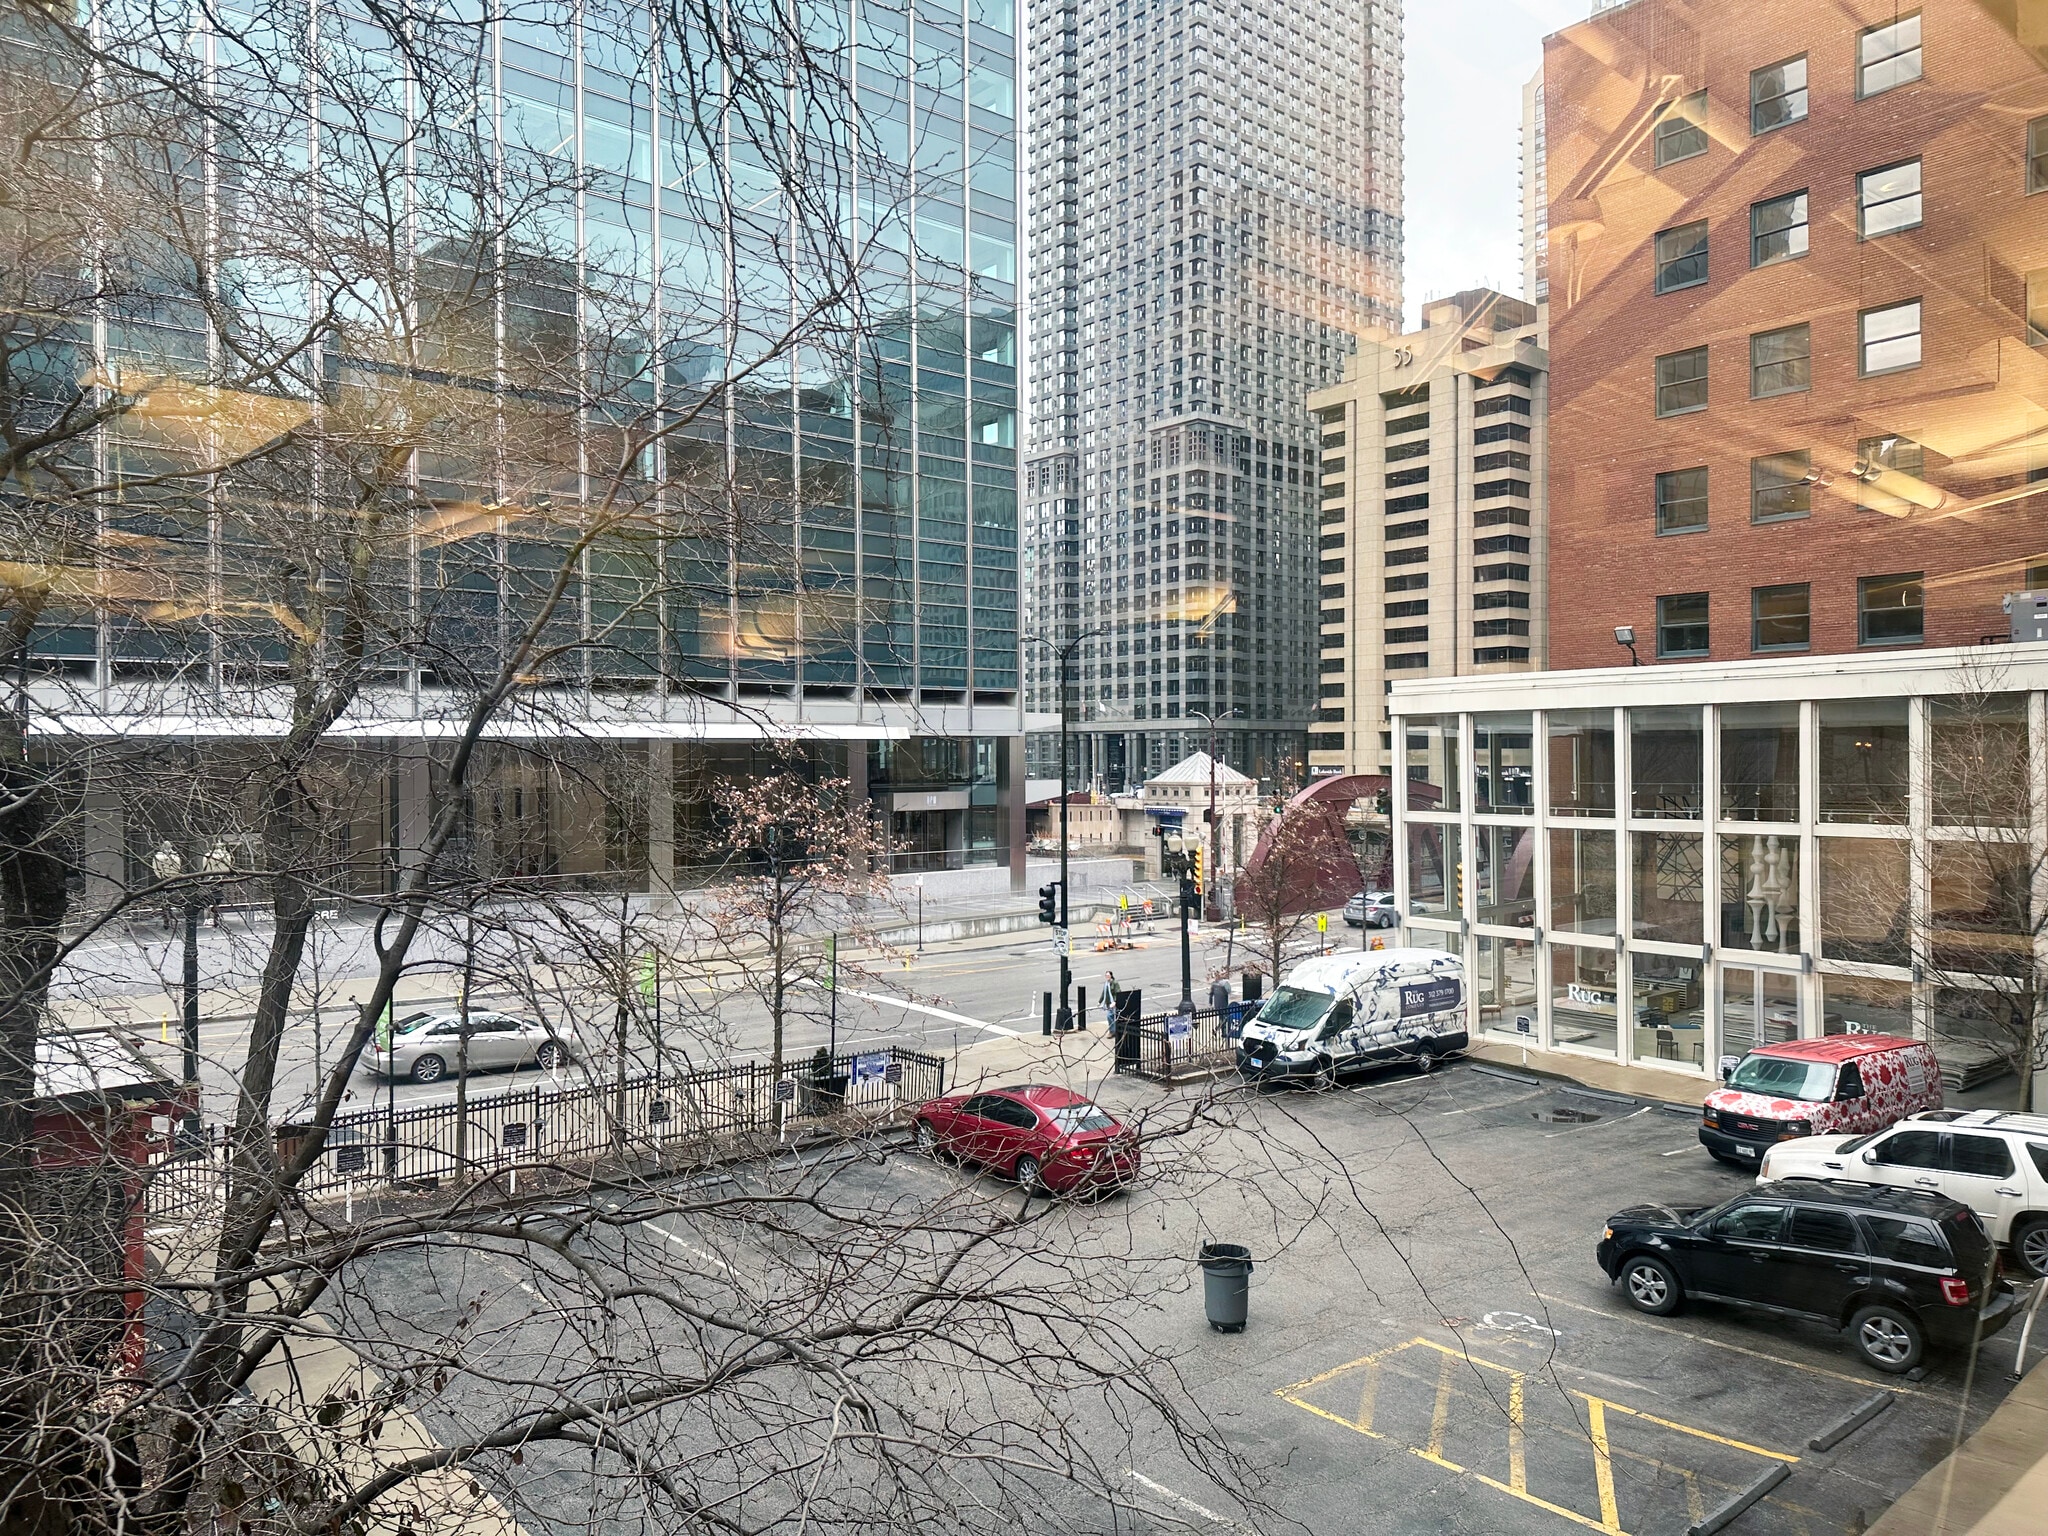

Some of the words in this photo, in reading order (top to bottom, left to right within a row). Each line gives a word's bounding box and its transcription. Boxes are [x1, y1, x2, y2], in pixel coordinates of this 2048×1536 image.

[1393, 344, 1413, 369] 55
[1404, 990, 1425, 1005] RUG
[1428, 990, 1436, 998] 312
[1567, 983, 1602, 1005] RUG
[1903, 1054, 1920, 1068] RUG
[1736, 1121, 1759, 1131] GMC
